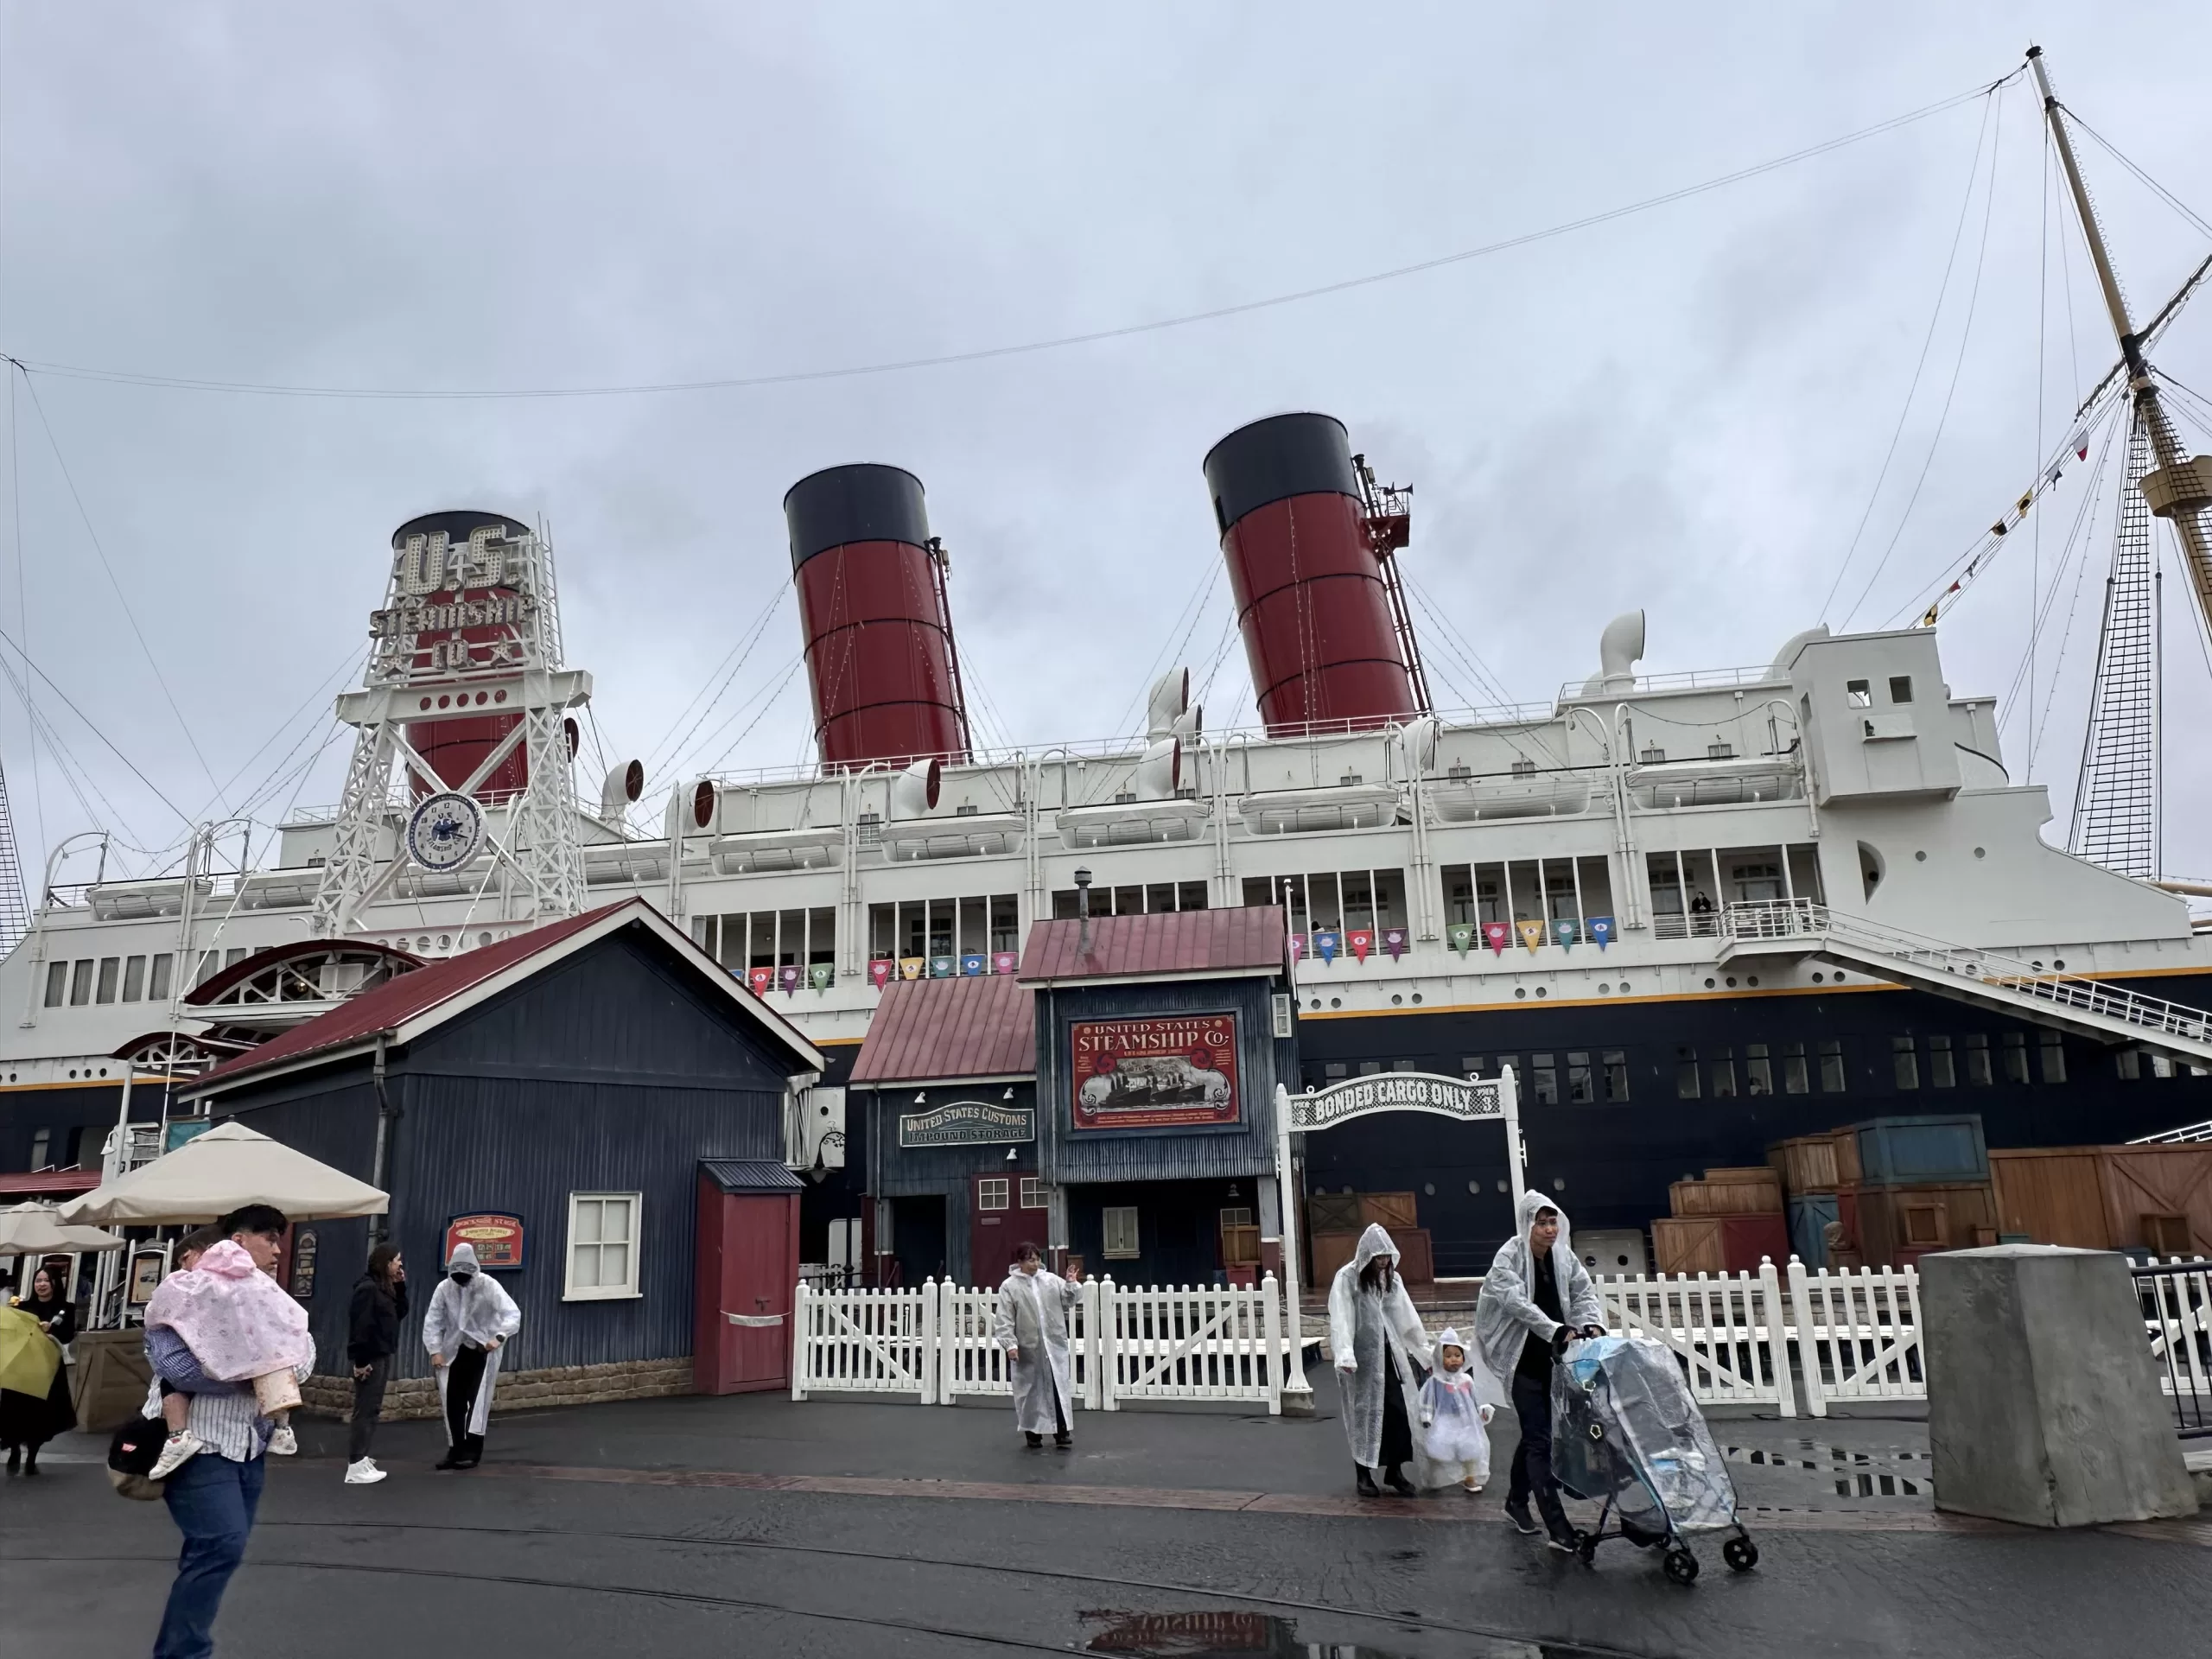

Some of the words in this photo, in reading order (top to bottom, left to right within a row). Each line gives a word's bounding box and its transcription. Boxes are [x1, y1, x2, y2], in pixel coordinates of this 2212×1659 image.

[369, 594, 539, 639] STEAMSHIP
[1095, 1023, 1151, 1034] UNITED
[1156, 1020, 1210, 1031] STATES
[1078, 1031, 1198, 1052] STEAMSHIP
[1315, 1083, 1374, 1122] BONDED
[1377, 1079, 1427, 1103] CARGO
[1431, 1081, 1471, 1111] ONLY
[907, 1115, 944, 1132] UNITED
[944, 1107, 980, 1122] STATES
[982, 1107, 1027, 1126] CUSTOMS
[909, 1129, 967, 1142] IMPOUND
[970, 1128, 1026, 1140] STORAGE
